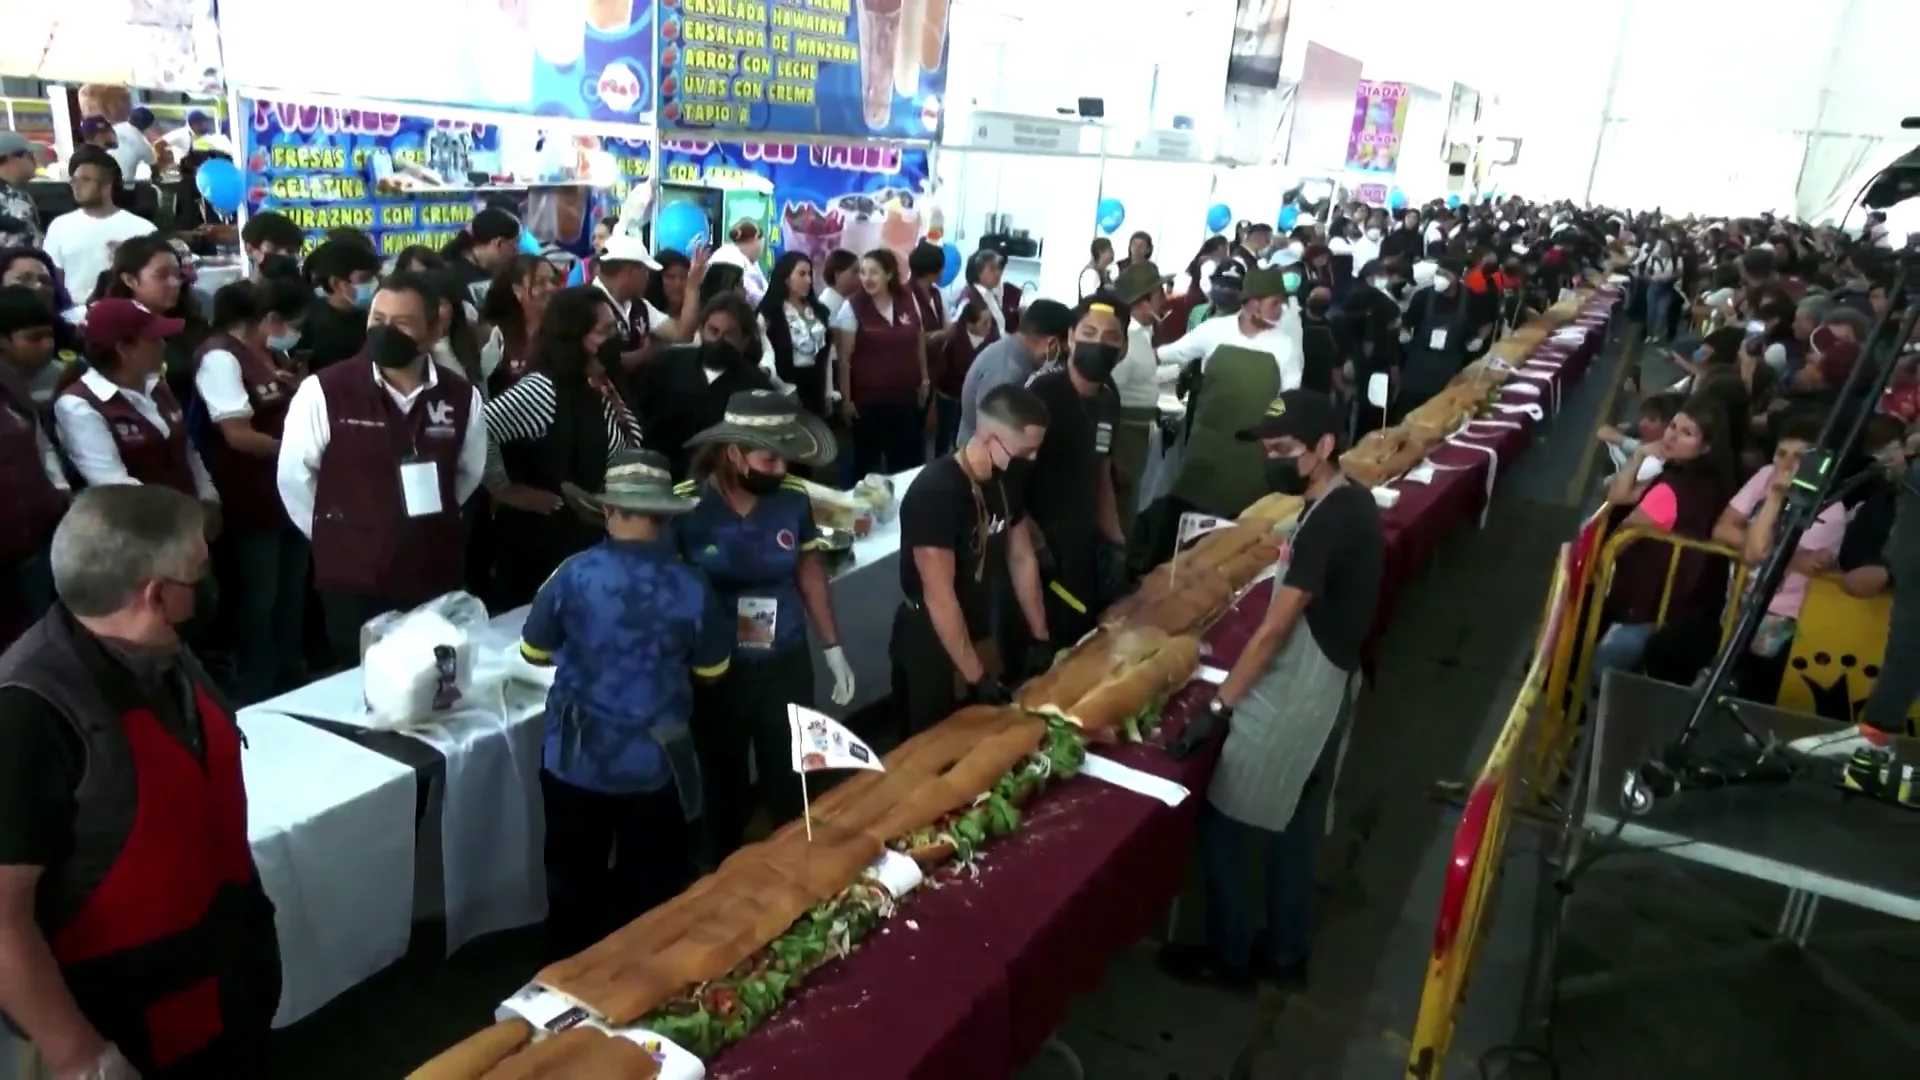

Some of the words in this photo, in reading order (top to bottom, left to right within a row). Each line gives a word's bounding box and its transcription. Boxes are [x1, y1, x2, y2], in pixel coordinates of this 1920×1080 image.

[685, 0, 765, 22] ENSALADA
[773, 8, 845, 35] HAWAIANA
[685, 21, 765, 48] ENSALADA
[773, 35, 788, 51] DE
[796, 38, 857, 61] MANZANA
[685, 49, 736, 71] ARROZ
[743, 55, 770, 74] CON
[778, 61, 817, 80] LECHE
[684, 76, 726, 97] UVAS
[734, 80, 761, 98] CON
[769, 85, 814, 104] CREMA
[273, 147, 345, 169] FRESAS
[669, 164, 698, 180] CON
[273, 177, 365, 198] GELATINA
[383, 207, 414, 225] CON
[422, 206, 474, 224] CREMA
